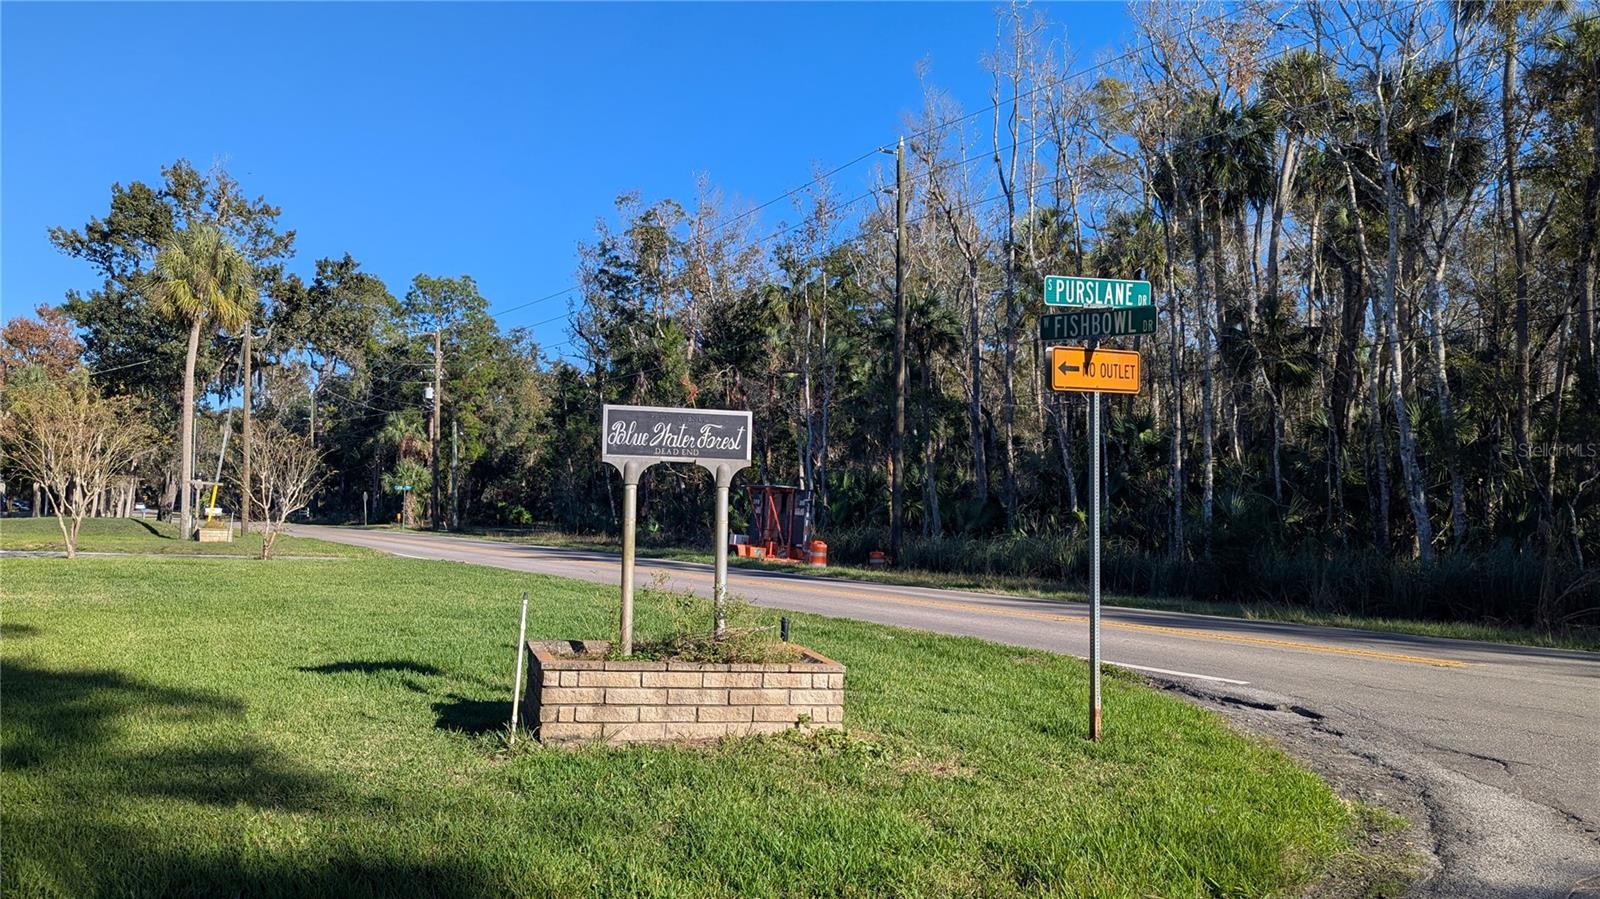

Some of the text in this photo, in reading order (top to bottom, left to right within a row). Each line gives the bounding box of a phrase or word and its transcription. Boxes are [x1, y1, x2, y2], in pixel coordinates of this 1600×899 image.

[1048, 279, 1147, 306] S PURSLANE DR
[1043, 311, 1153, 337] W FISHBOWL DR
[1082, 362, 1136, 379] NO OUTLET
[608, 420, 746, 450] Blue Water Forest
[655, 447, 699, 457] DEAD END
